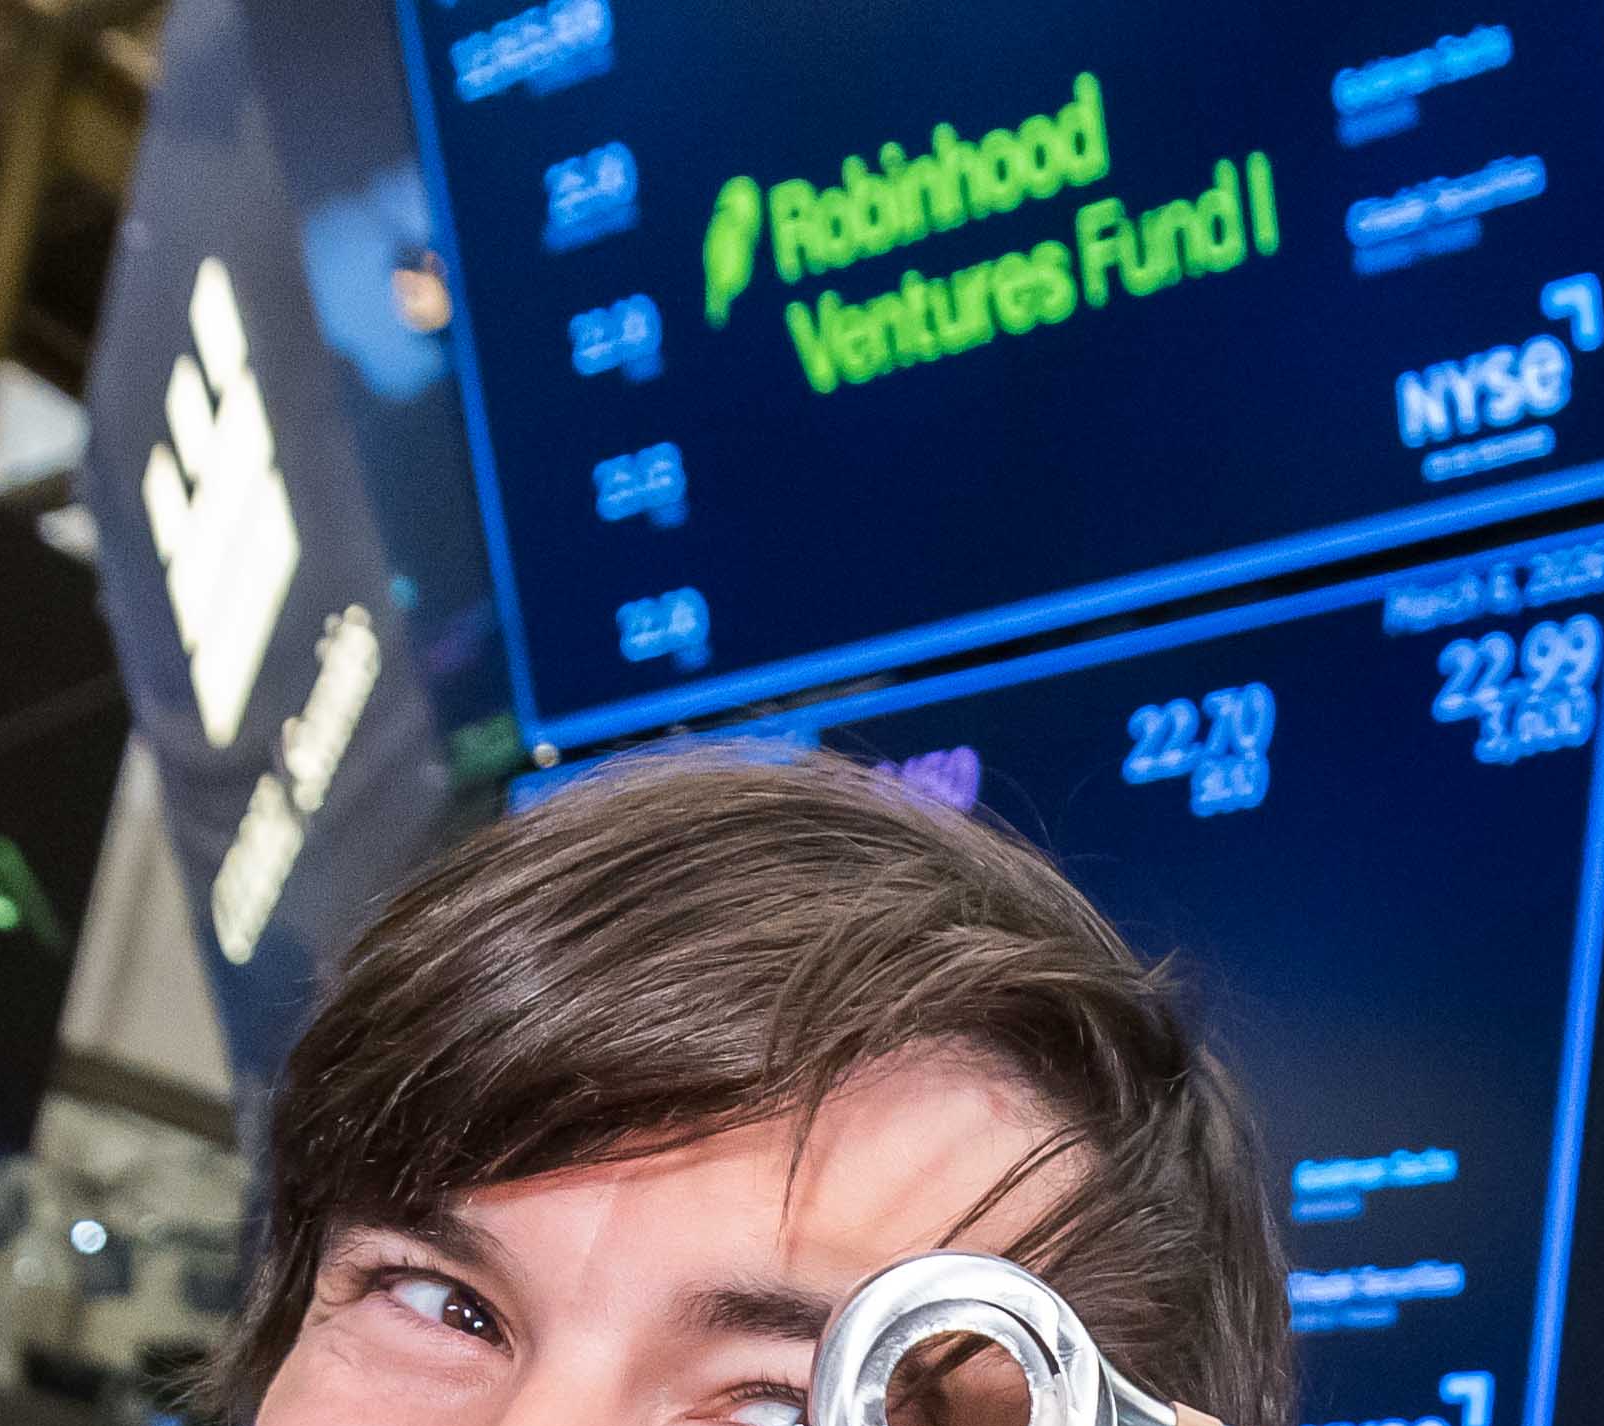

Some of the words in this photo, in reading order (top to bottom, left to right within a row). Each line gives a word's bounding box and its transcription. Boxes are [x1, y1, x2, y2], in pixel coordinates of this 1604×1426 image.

[768, 71, 1109, 284] Robinhood
[785, 239, 1077, 394] Ventures
[1075, 157, 1248, 308] Fund
